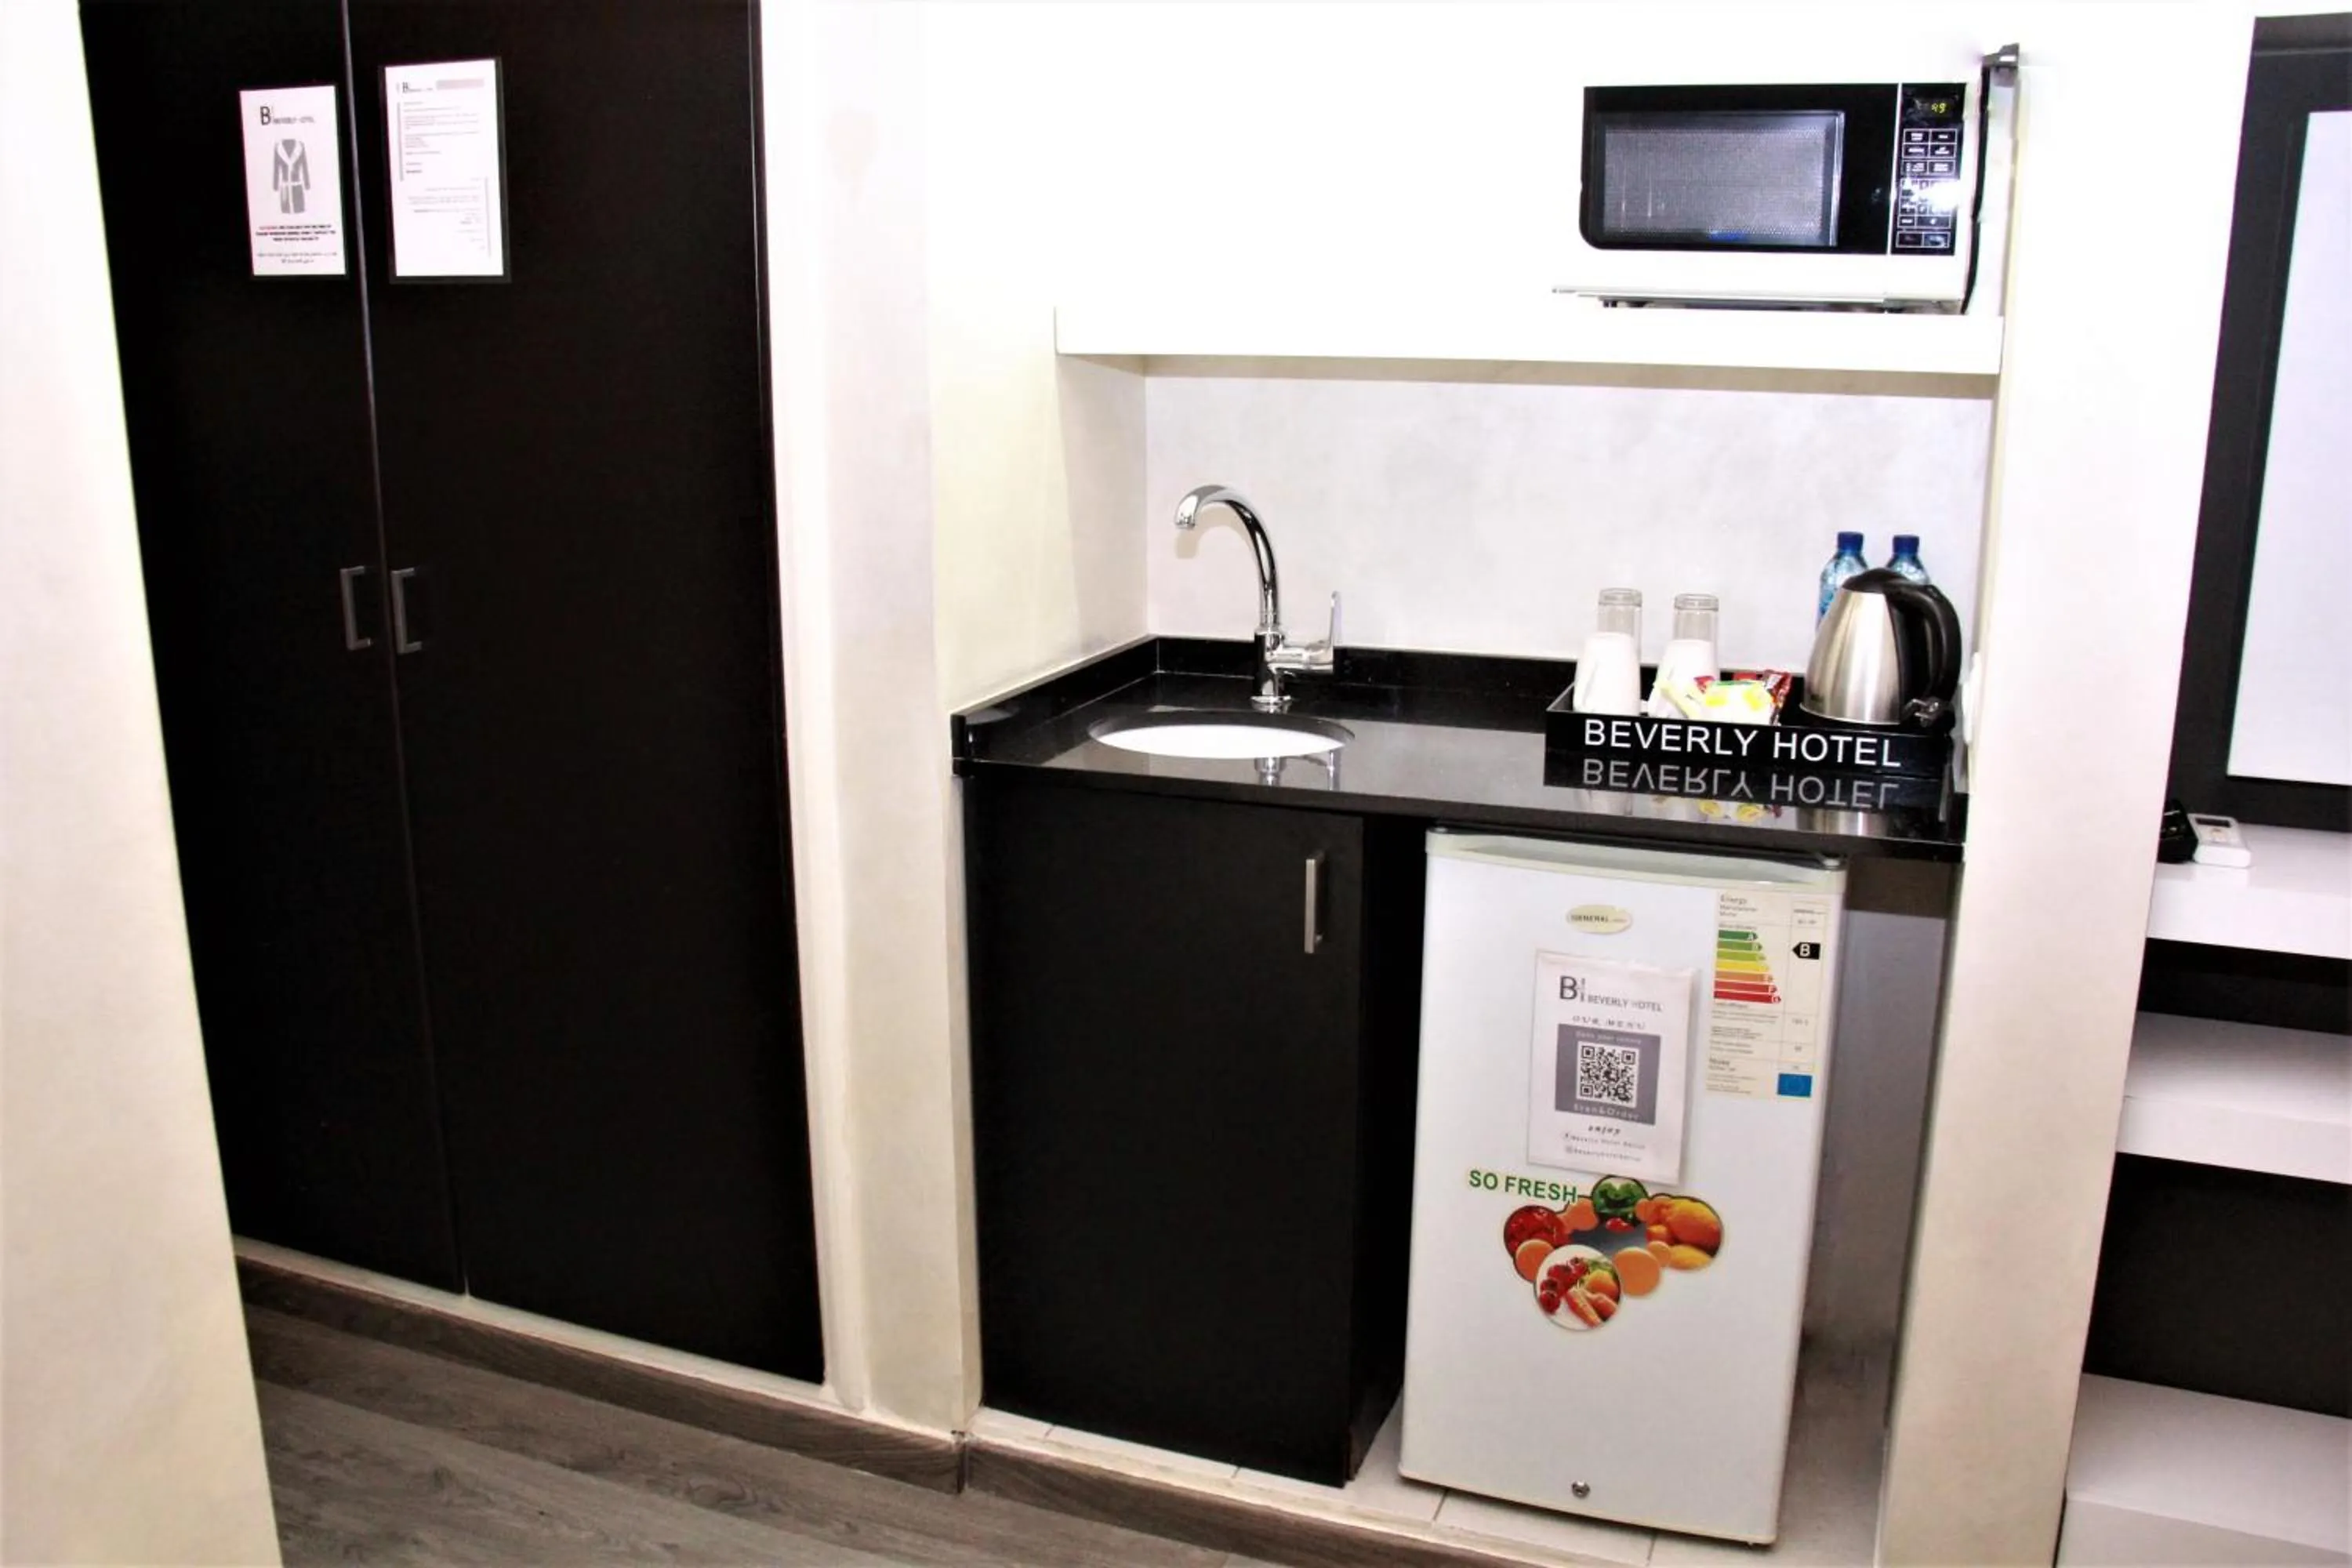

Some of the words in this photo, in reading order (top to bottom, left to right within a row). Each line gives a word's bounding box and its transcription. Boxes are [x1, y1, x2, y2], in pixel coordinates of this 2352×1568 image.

[260, 106, 271, 125] B
[1584, 718, 1758, 757] BEVERLY
[1773, 732, 1901, 768] HOTEL
[1799, 942, 1810, 956] B
[1559, 975, 1577, 1000] B
[1588, 994, 1629, 1008] BEVERLY
[1469, 1170, 1498, 1190] SO
[1504, 1176, 1577, 1203] FRESH
